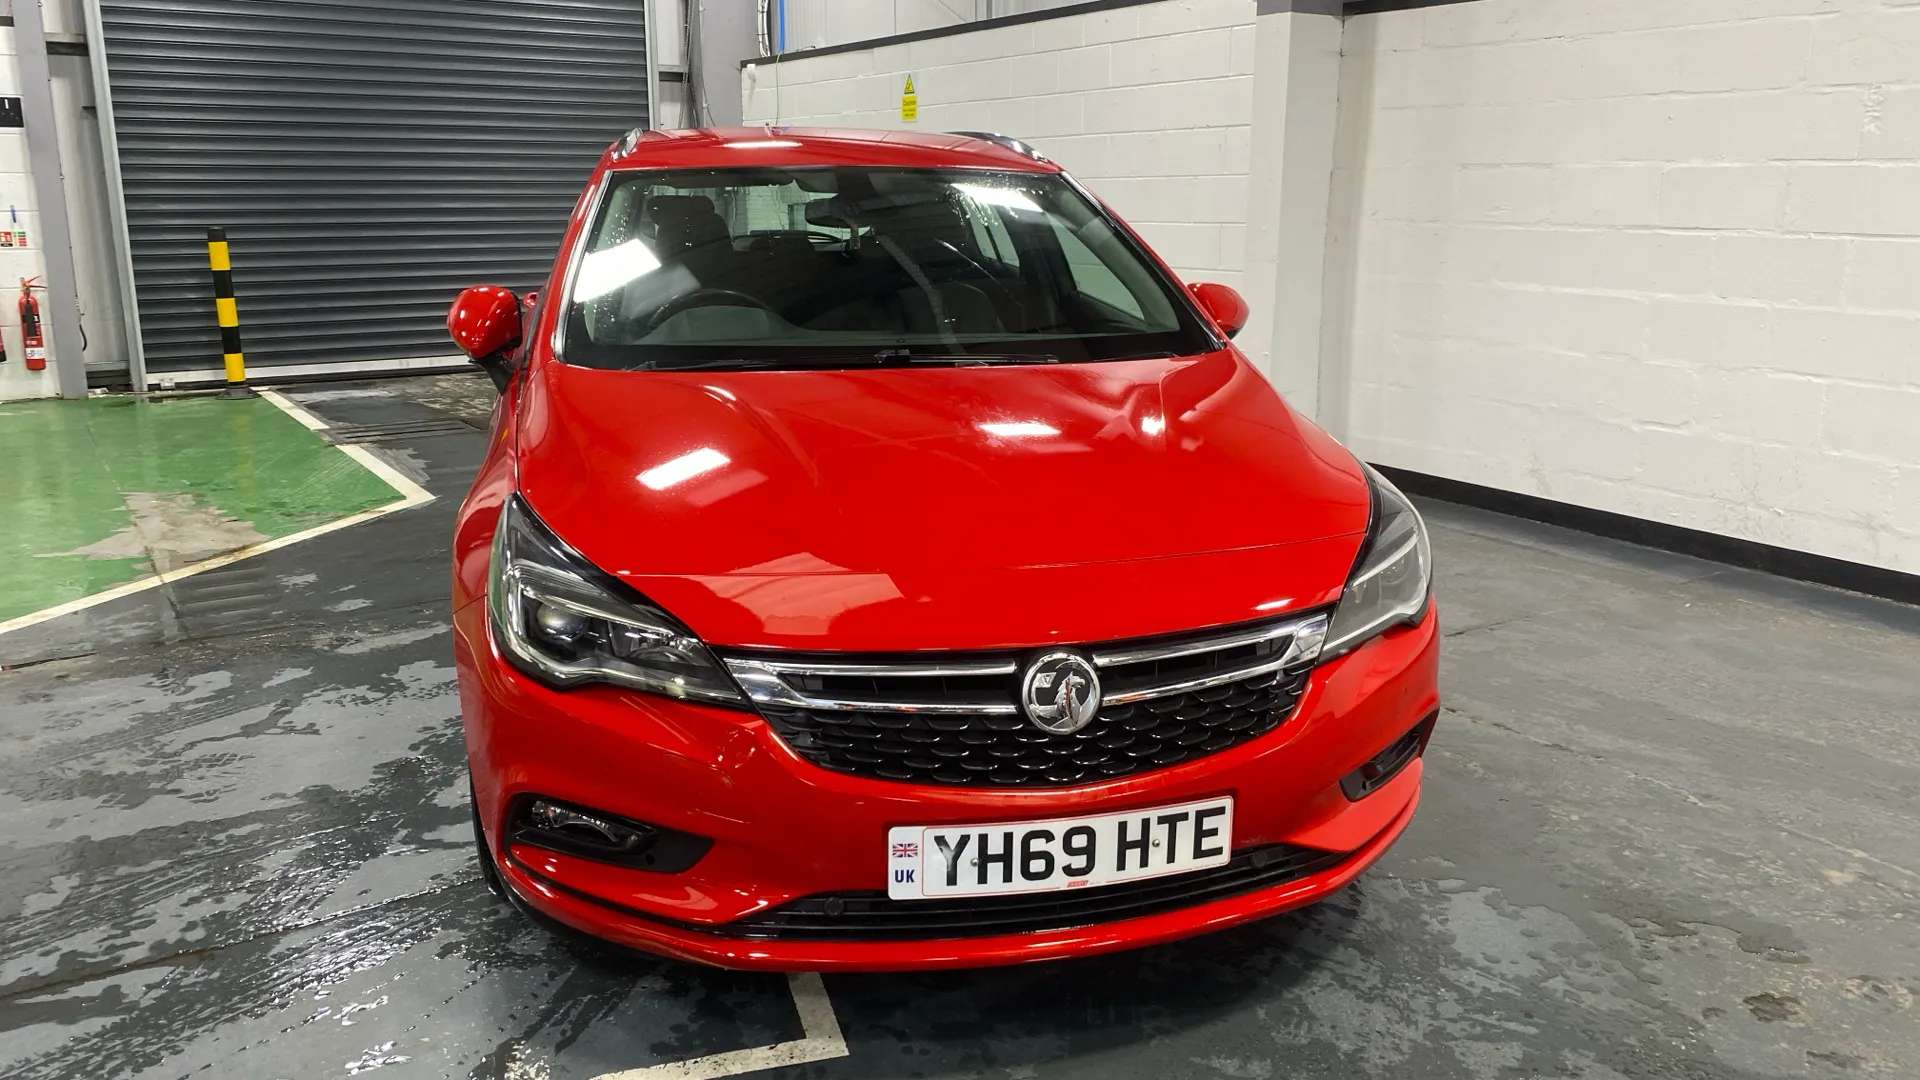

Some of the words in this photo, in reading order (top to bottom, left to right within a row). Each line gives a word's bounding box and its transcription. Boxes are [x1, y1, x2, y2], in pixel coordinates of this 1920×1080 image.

[934, 826, 1096, 886] YH69
[1116, 806, 1226, 872] HTE
[895, 869, 915, 883] UK
